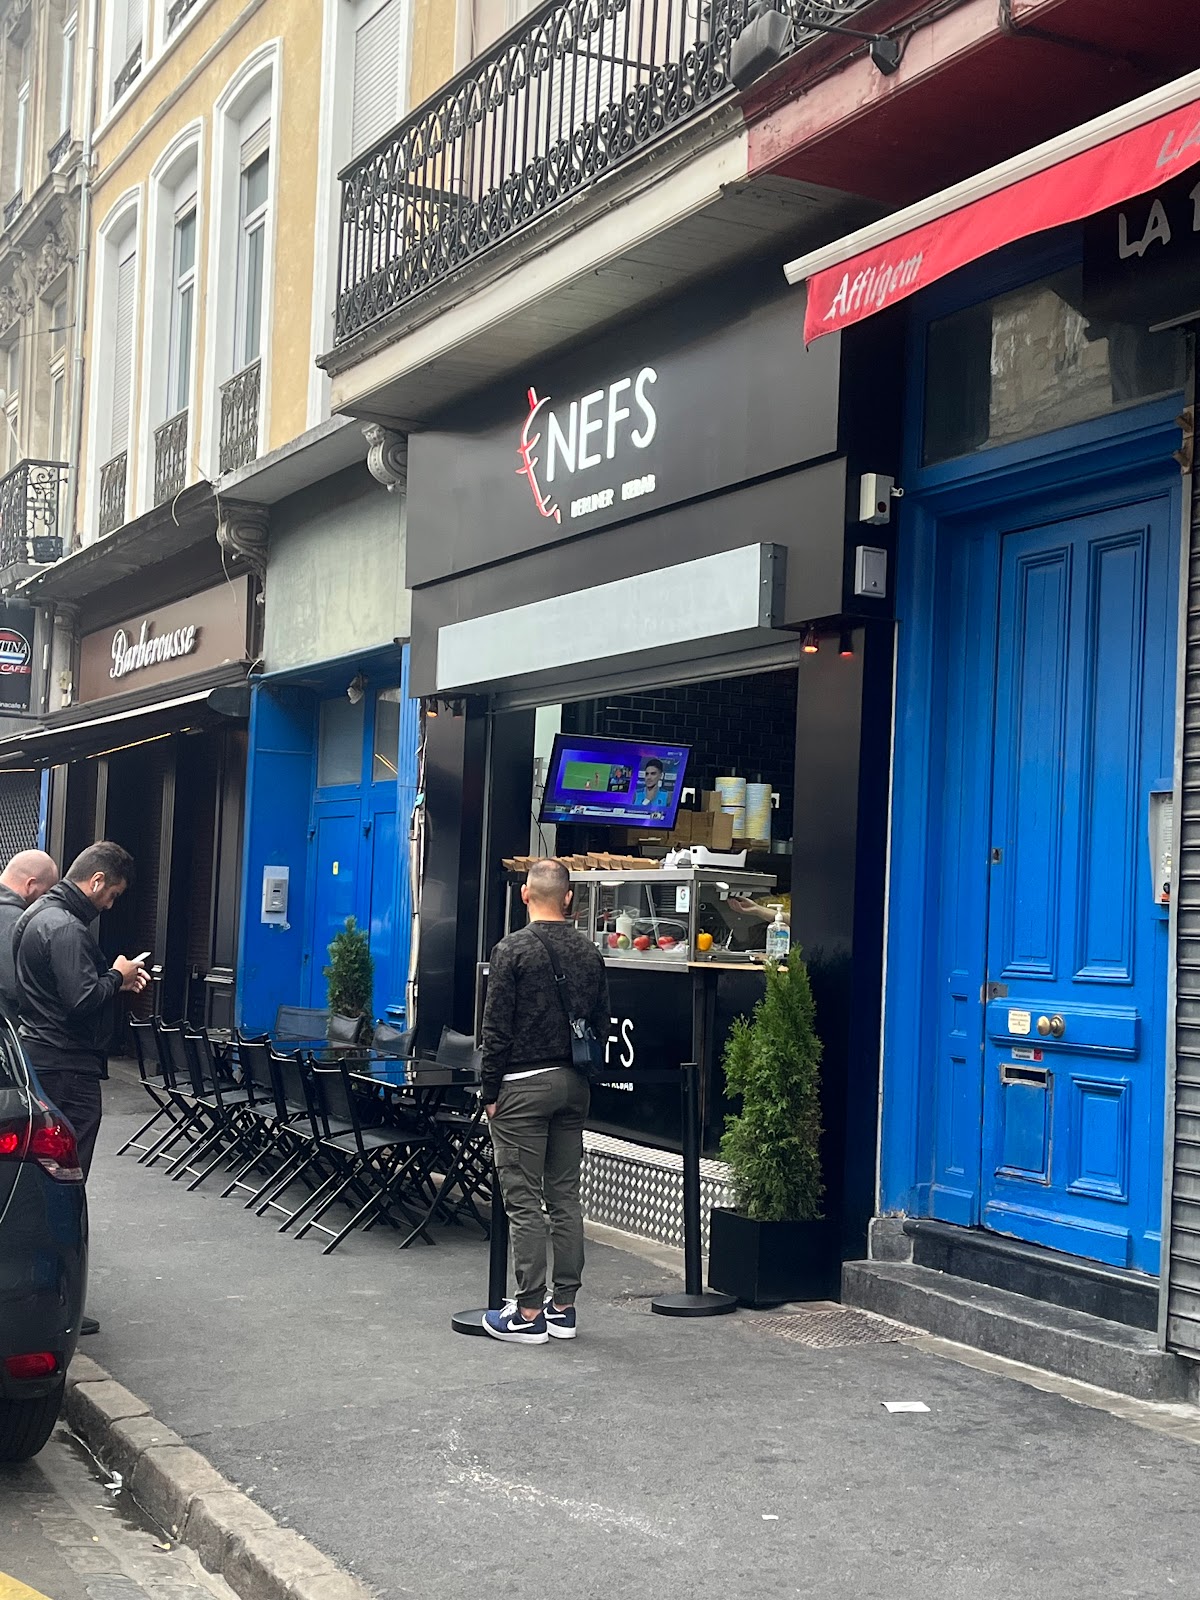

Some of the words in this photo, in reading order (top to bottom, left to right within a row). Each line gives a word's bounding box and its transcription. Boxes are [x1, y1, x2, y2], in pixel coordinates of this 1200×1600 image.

[1118, 198, 1171, 260] LA
[822, 250, 923, 322] Affligem
[547, 367, 657, 481] NEFS
[109, 619, 196, 679] Barberousse
